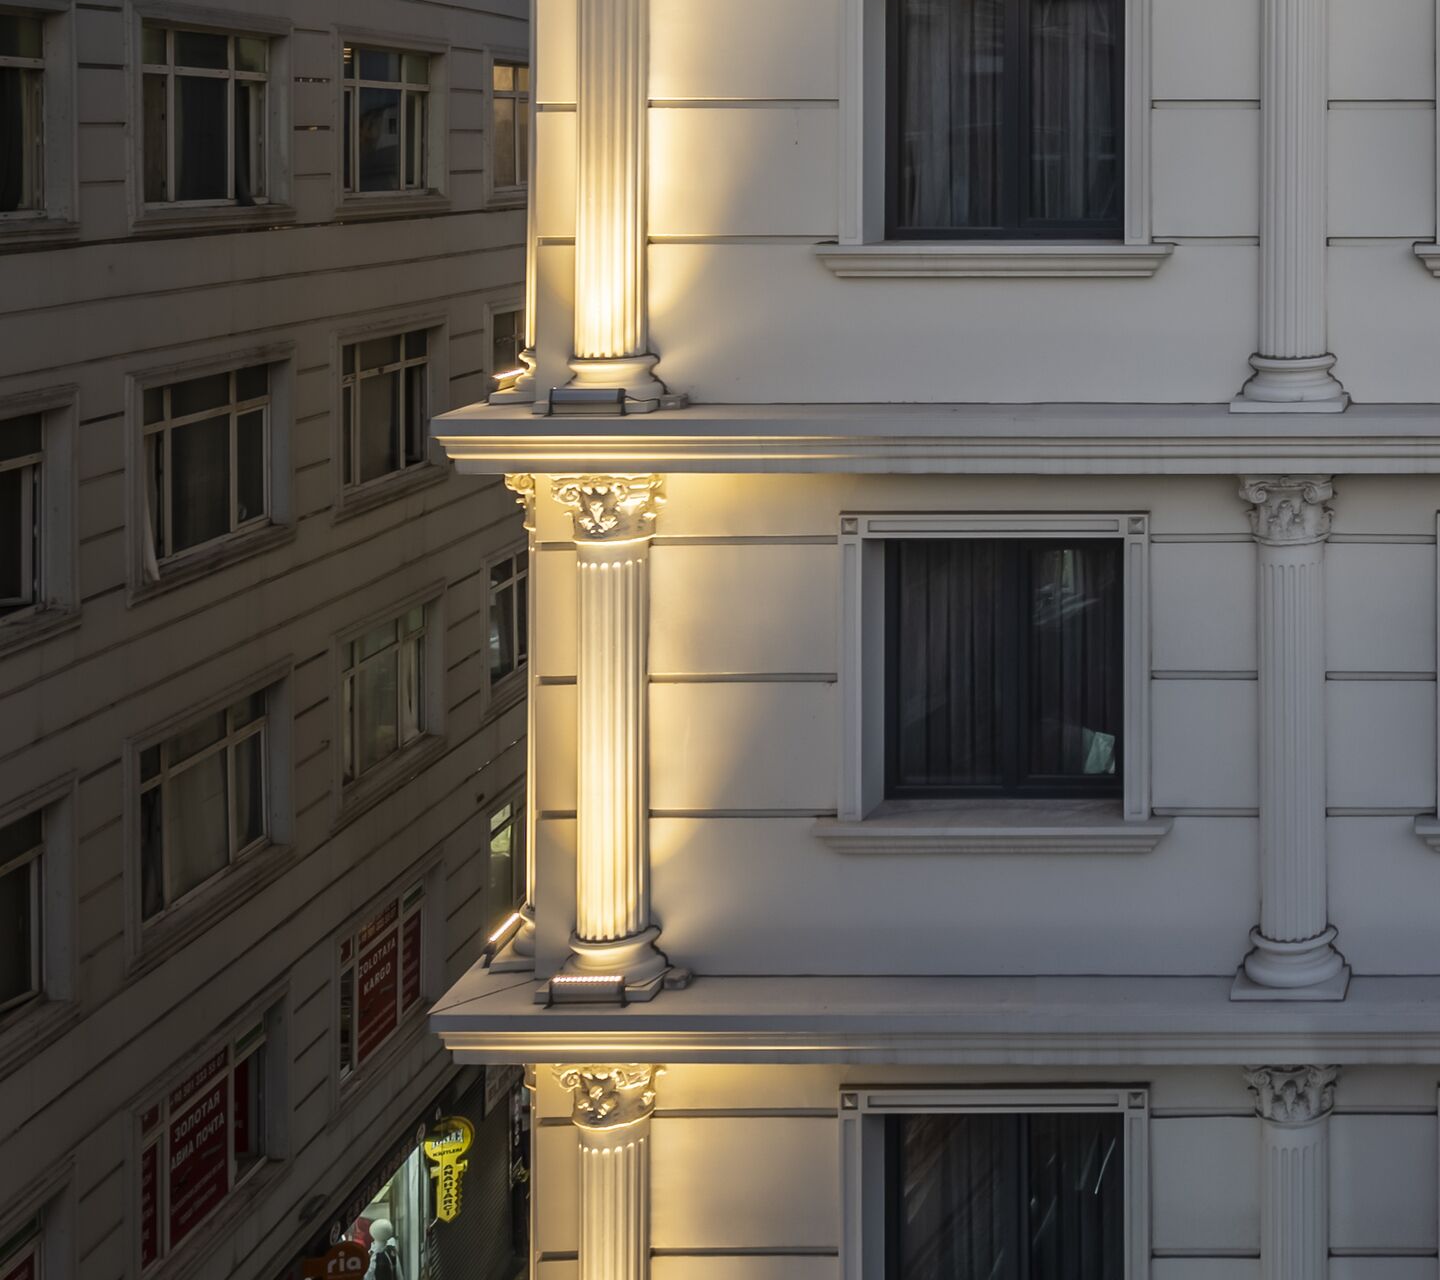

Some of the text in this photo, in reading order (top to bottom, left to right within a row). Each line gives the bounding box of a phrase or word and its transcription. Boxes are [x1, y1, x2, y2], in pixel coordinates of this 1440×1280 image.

[359, 937, 396, 978] ZOLOTAYA
[363, 962, 391, 996] KARGO
[174, 1090, 220, 1143] ЗОЛОТАЯ
[170, 1111, 225, 1172] АВИА ПОЧТА
[443, 1164, 455, 1216] ANAHTARCI
[327, 1251, 362, 1273] ria
